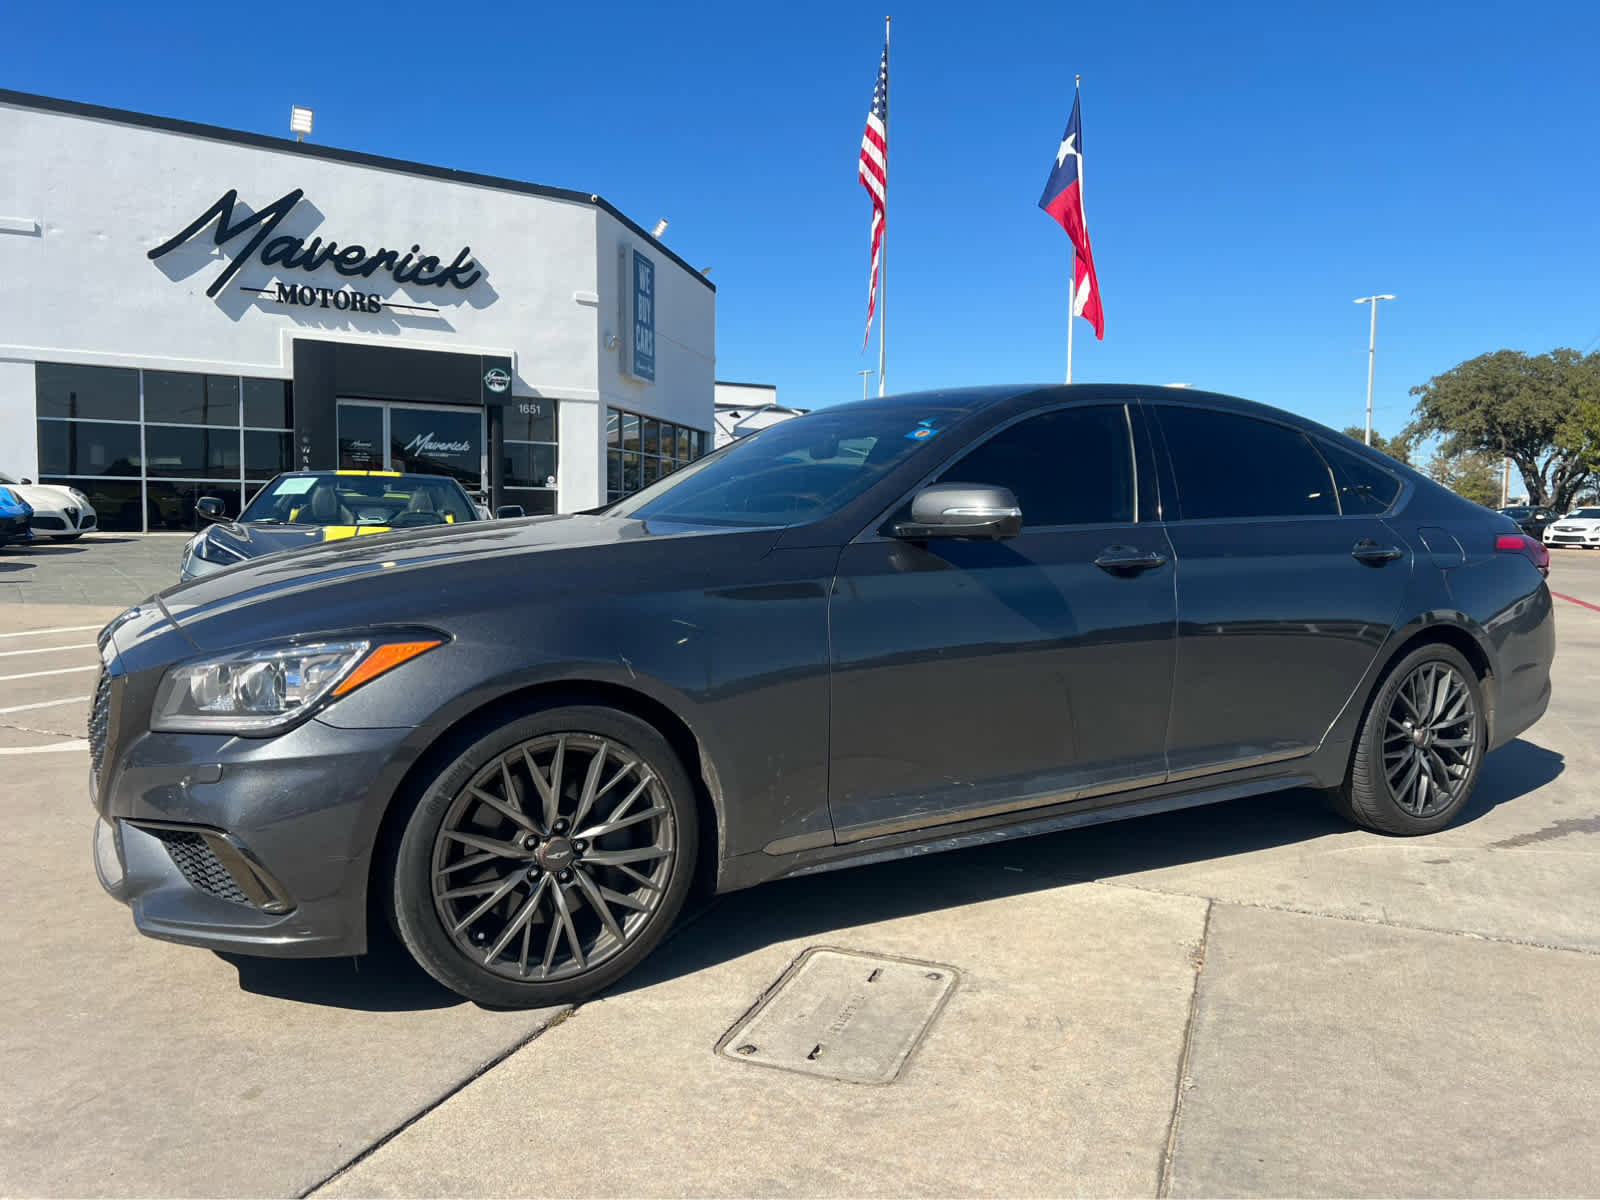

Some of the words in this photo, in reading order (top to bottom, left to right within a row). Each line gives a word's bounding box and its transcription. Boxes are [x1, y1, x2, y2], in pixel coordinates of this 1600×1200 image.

[147, 188, 482, 298] Maverick
[275, 282, 382, 314] MOTORS
[519, 403, 541, 415] 1651
[404, 432, 470, 457] Maverick
